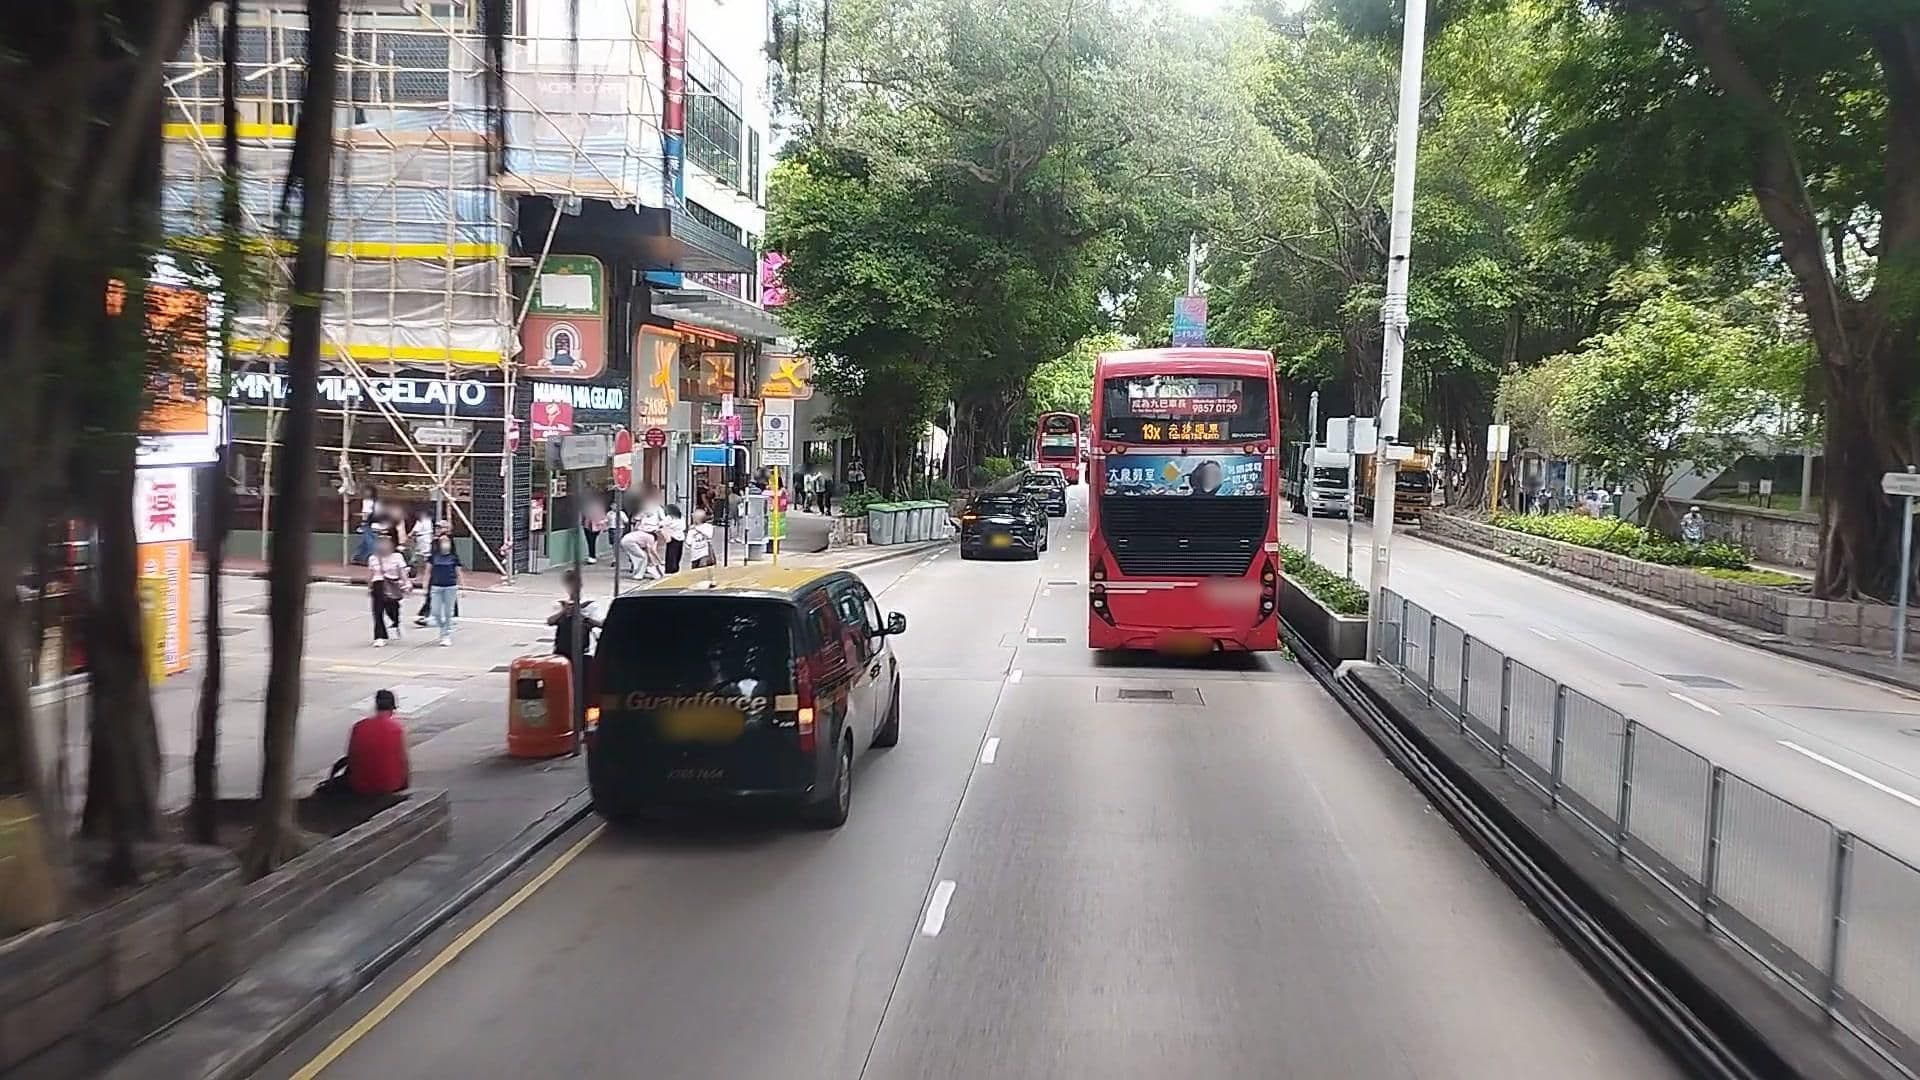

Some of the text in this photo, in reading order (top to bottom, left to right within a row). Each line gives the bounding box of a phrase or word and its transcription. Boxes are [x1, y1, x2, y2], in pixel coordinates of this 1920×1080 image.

[371, 379, 486, 406] GELATO
[533, 382, 623, 410] MAMMA MIA GELATO
[1216, 404, 1238, 413] 0129
[627, 691, 767, 711] Guardforce
